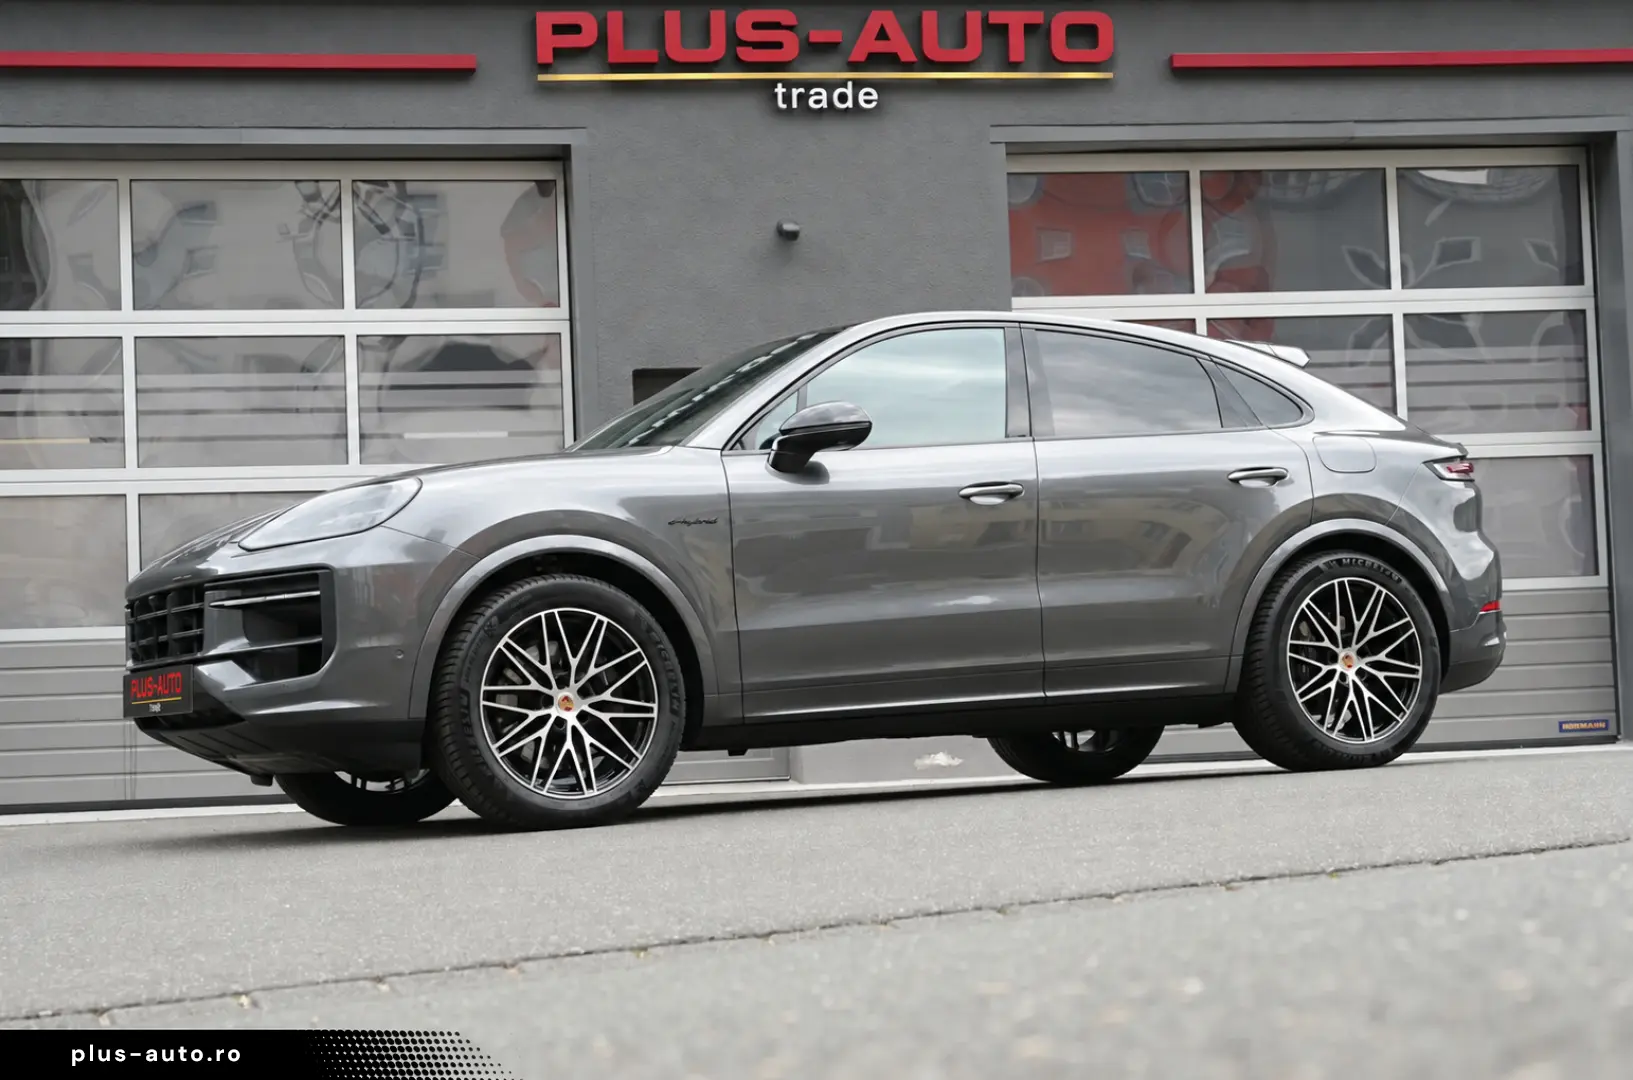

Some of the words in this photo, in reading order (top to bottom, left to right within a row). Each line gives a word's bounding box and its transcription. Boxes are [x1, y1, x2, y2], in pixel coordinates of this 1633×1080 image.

[535, 10, 1114, 64] PLUS-AUTO
[774, 81, 878, 109] trade
[130, 671, 182, 699] PLUS-AUTO
